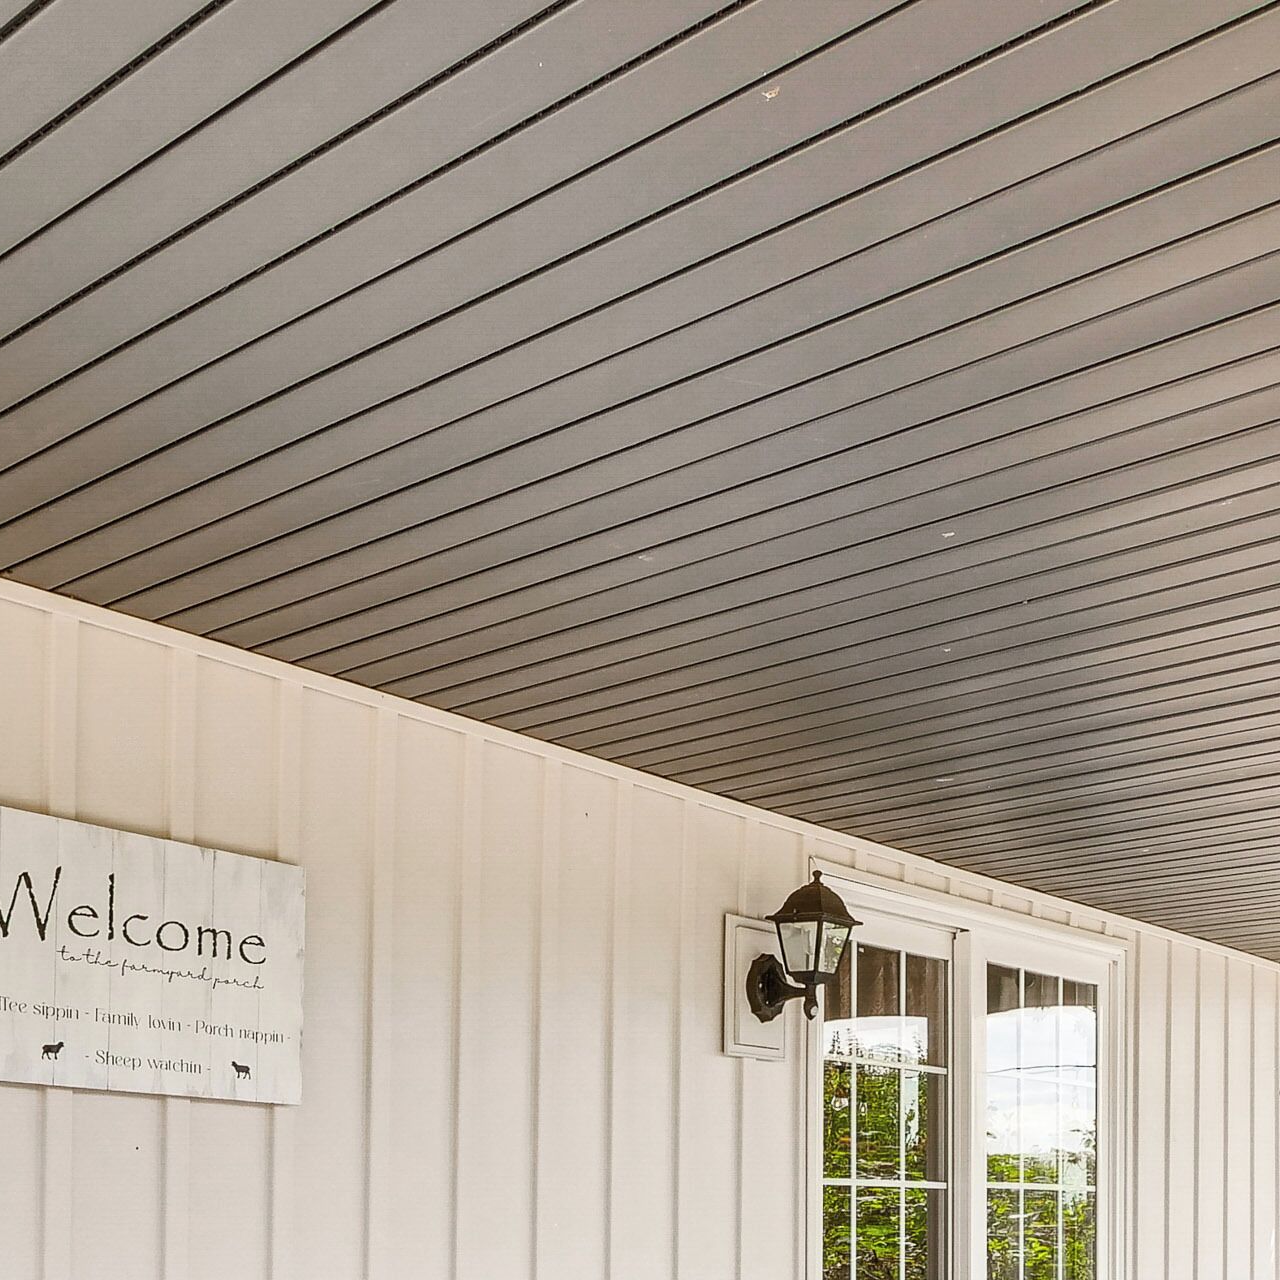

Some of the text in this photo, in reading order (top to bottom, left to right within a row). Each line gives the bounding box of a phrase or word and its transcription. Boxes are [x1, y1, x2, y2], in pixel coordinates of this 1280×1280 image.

[56, 944, 265, 990] to the farmyard porch
[32, 1001, 80, 1021] sippin
[94, 1006, 141, 1030] Family
[148, 1013, 182, 1033] lovin
[195, 1018, 235, 1039] Porch
[238, 1027, 285, 1045] nappin
[94, 1049, 142, 1071] Sheep
